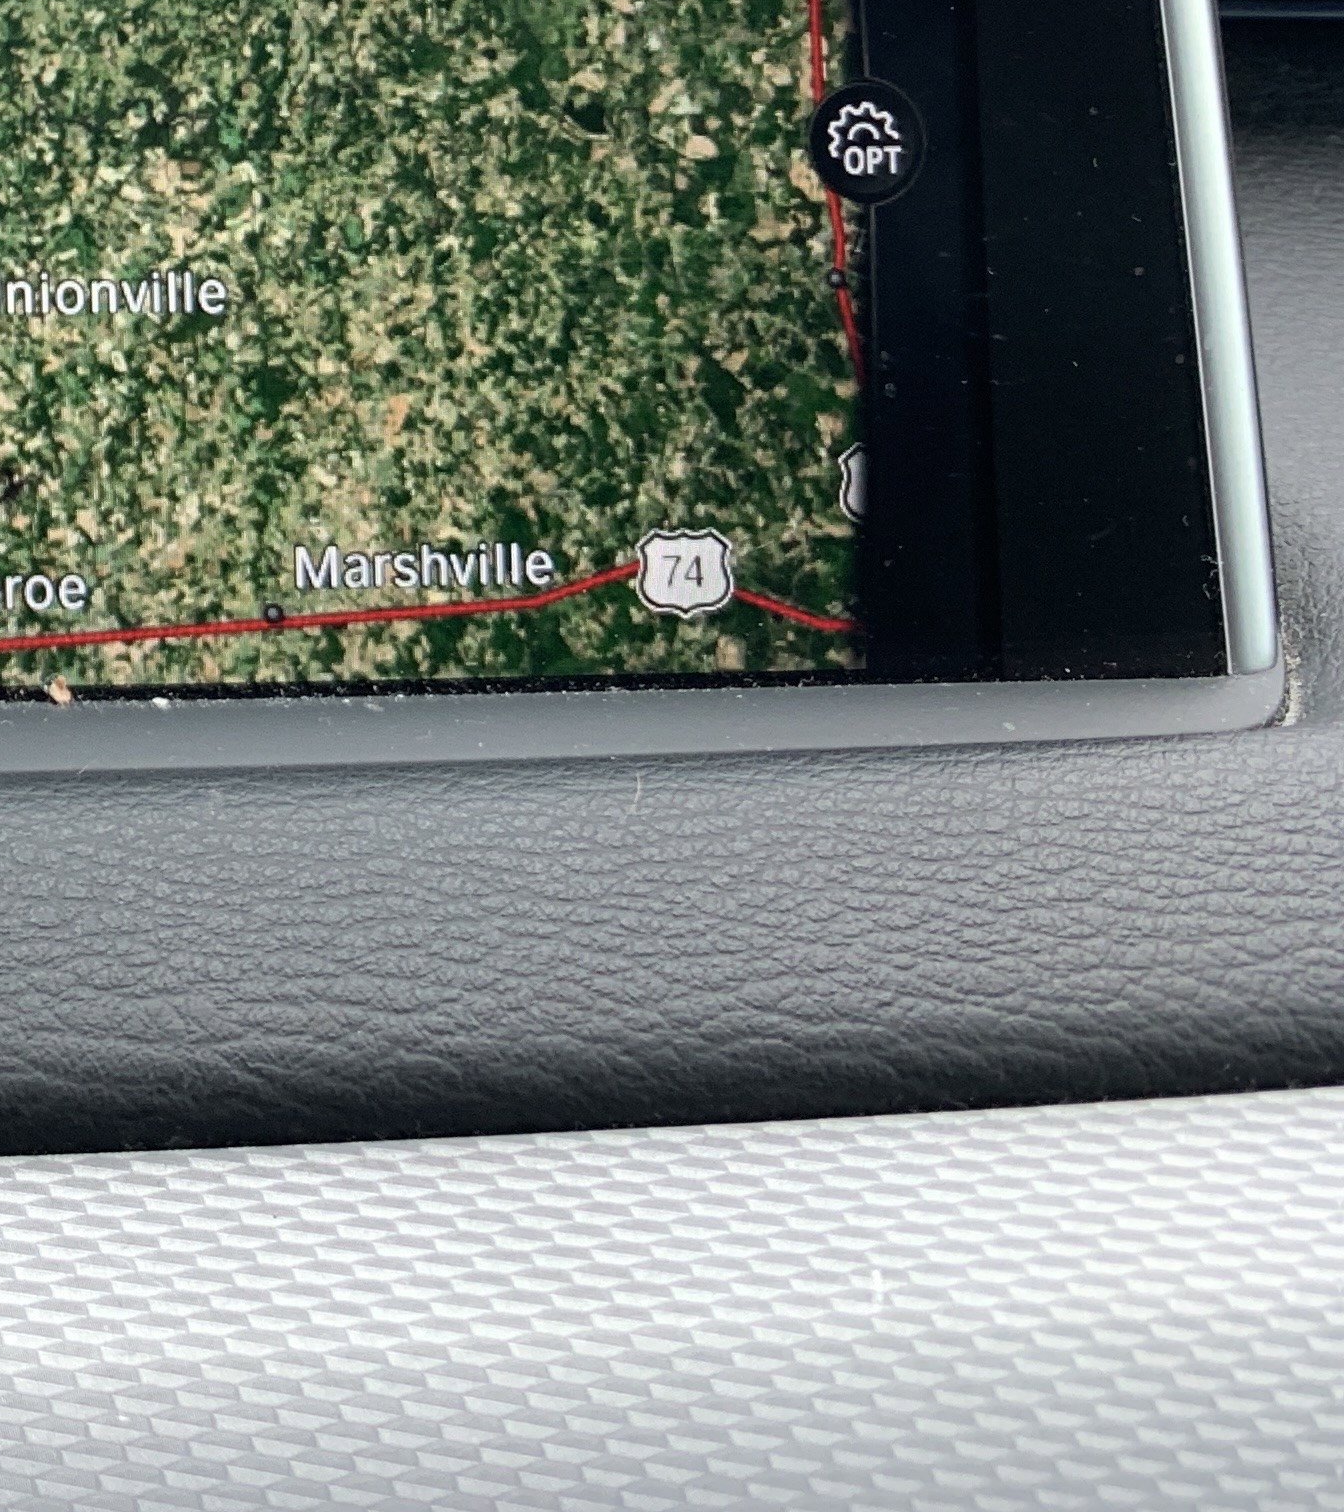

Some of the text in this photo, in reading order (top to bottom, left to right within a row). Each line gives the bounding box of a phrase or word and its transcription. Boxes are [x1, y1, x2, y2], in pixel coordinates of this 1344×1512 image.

[843, 145, 902, 175] OPT
[294, 543, 555, 588] Marshville
[662, 554, 705, 587] 74
